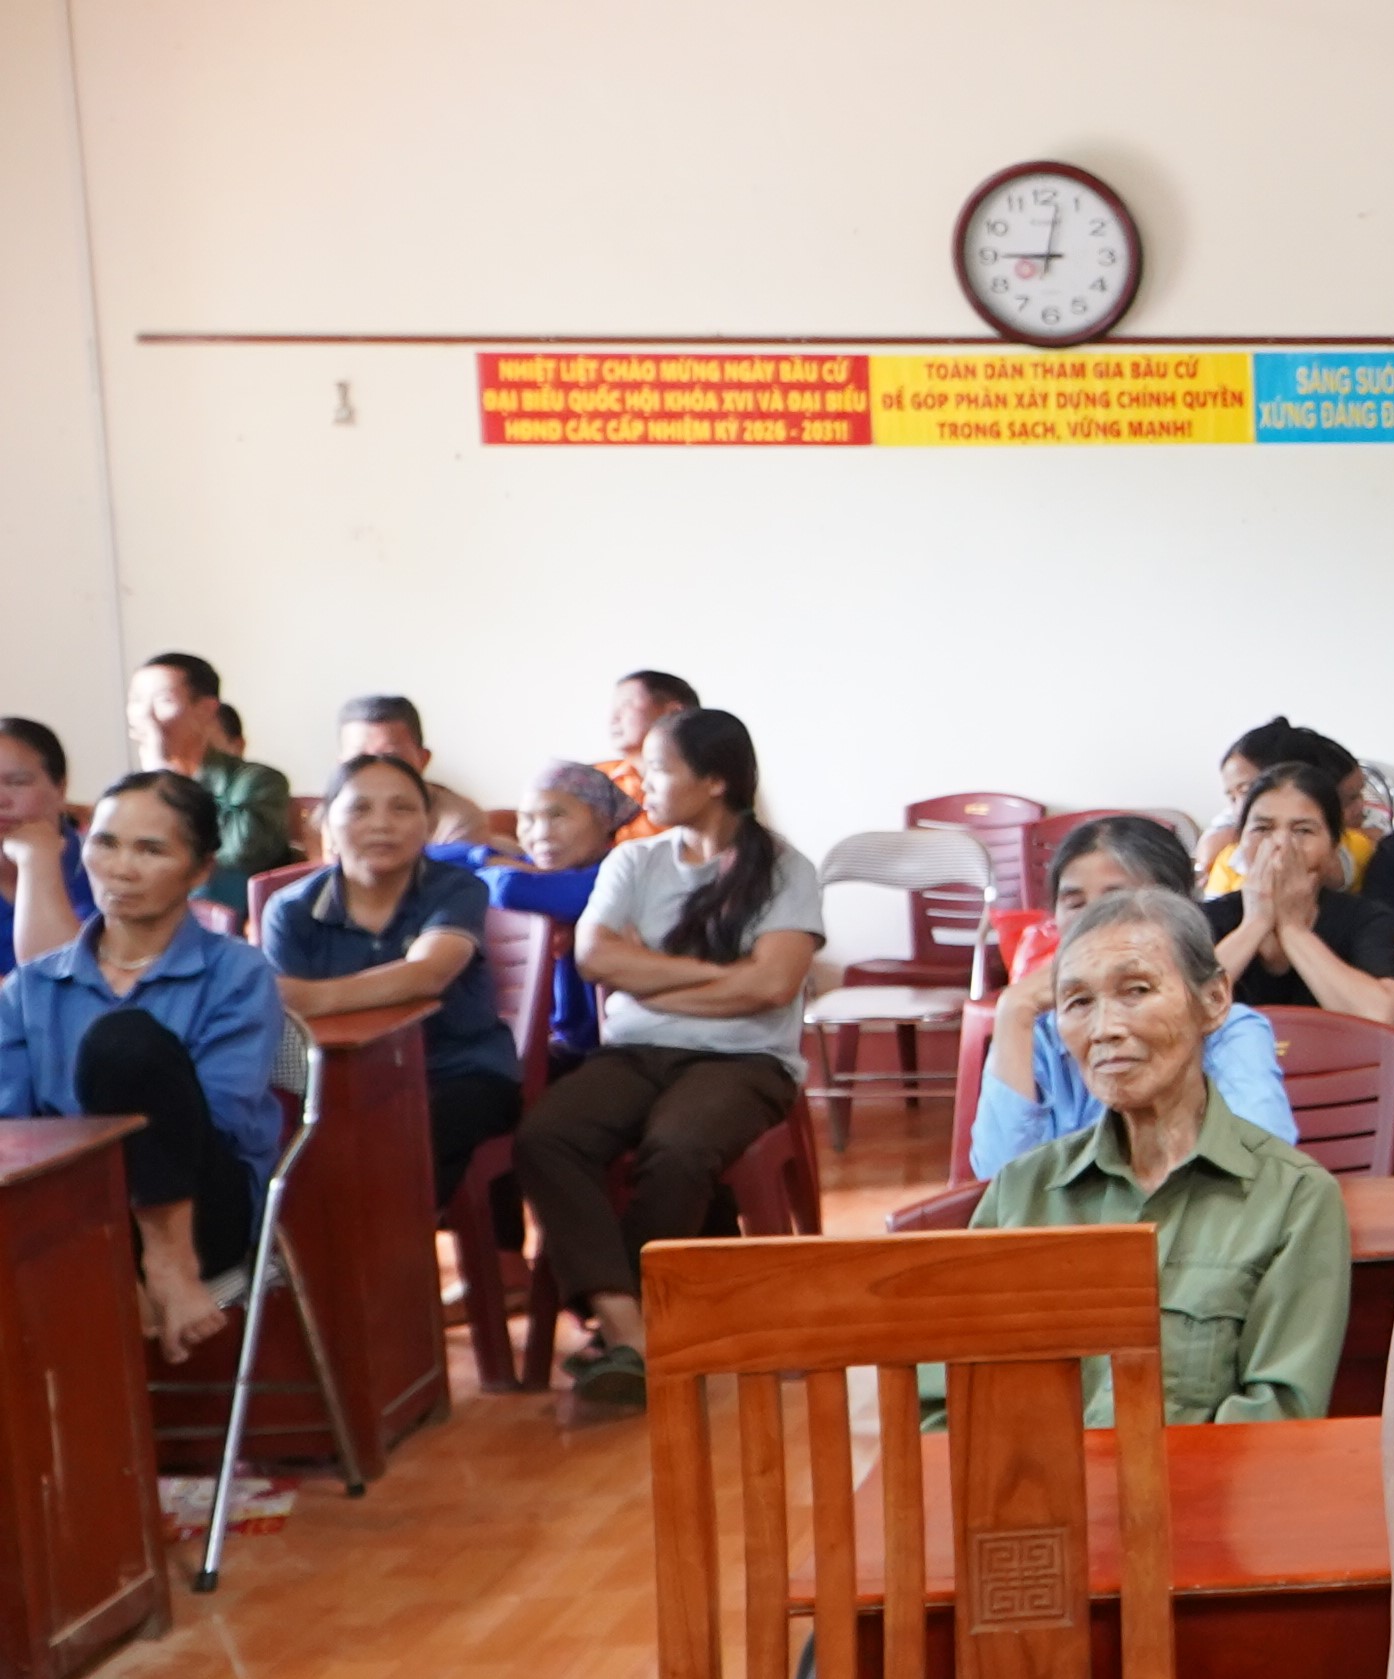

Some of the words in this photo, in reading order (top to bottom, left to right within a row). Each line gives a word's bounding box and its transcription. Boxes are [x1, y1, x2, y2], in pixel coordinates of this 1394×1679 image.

[1008, 196, 1024, 212] 11
[1032, 189, 1057, 206] 12
[986, 219, 1009, 237] 10
[1089, 219, 1106, 237] 2
[978, 248, 998, 265] 9
[1099, 248, 1116, 266] 3
[991, 276, 1009, 293] 8
[1089, 277, 1107, 292] 4
[1016, 296, 1030, 312] 7
[1071, 298, 1087, 315] 5
[1041, 307, 1061, 326] 6
[1296, 361, 1350, 395] SÁNG
[1260, 395, 1317, 429] XỨNG
[1320, 394, 1377, 429] ĐÁNG
